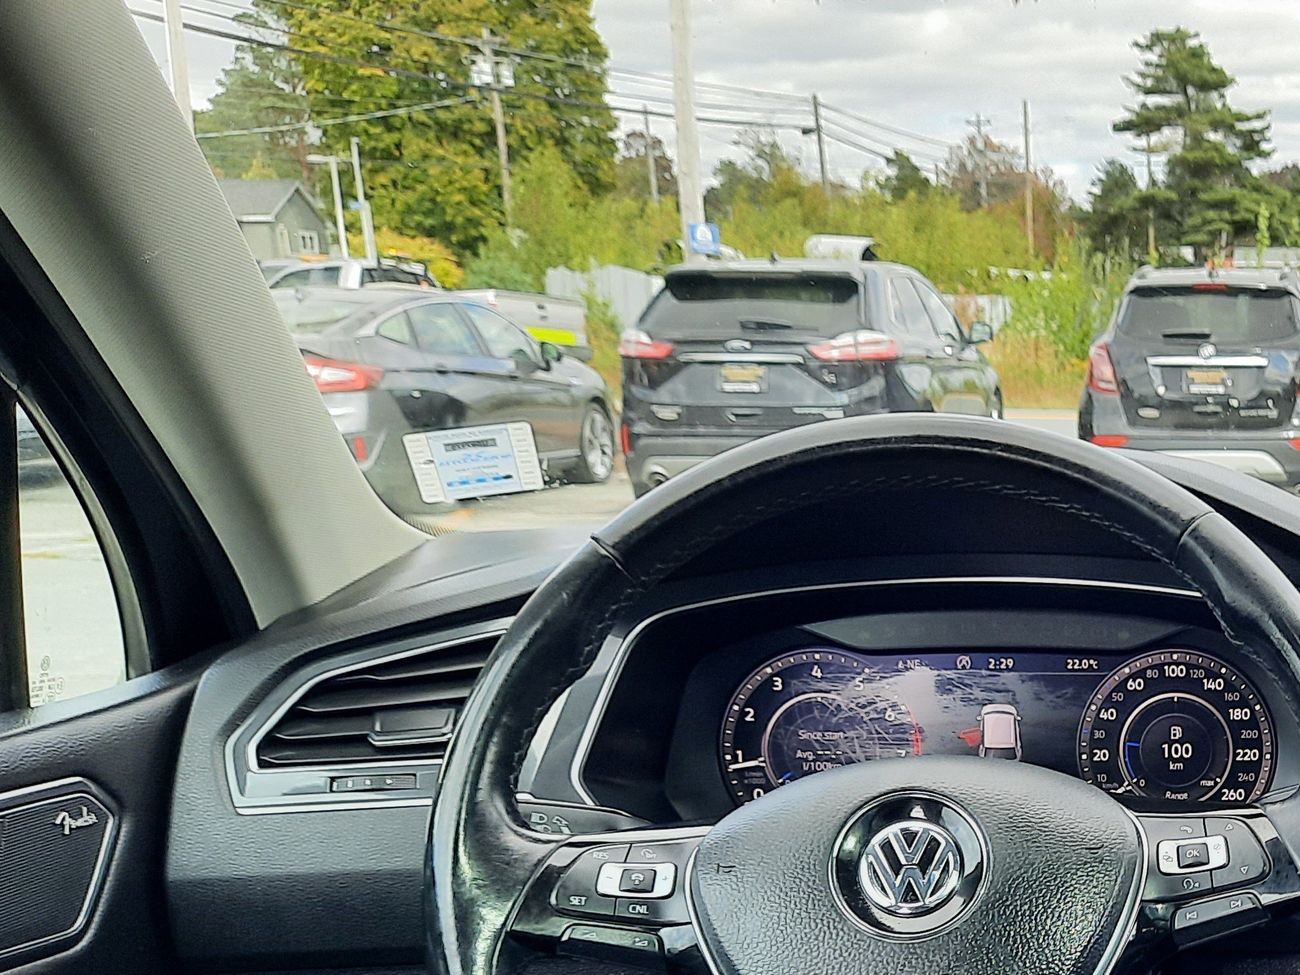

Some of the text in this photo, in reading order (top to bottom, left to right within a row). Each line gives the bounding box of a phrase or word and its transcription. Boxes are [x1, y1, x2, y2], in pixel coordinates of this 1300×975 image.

[988, 658, 1014, 669] 2:29
[811, 665, 823, 679] 4
[1146, 669, 1159, 679] 80
[1163, 665, 1187, 678] 100
[1189, 668, 1205, 679] 120
[772, 677, 783, 692] 3
[854, 678, 865, 691] 5
[1126, 678, 1144, 691] 60
[1203, 678, 1224, 691] 140
[1111, 692, 1124, 702] 50
[1224, 692, 1240, 702] 160
[744, 708, 756, 723] 2
[884, 708, 896, 722] 6
[1099, 708, 1117, 721] 40
[1228, 708, 1251, 721] 180
[798, 729, 822, 741] Since
[1093, 729, 1106, 740] 30
[1240, 729, 1259, 740] 200
[736, 750, 744, 763] 1
[796, 749, 817, 761] Avg.
[1092, 749, 1110, 762] 20
[1161, 742, 1193, 759] 100
[1235, 749, 1259, 762] 220
[1169, 760, 1184, 771] km
[1096, 773, 1107, 783] 10
[1139, 778, 1146, 788] 0
[1200, 779, 1215, 787] max
[1238, 772, 1255, 782] 240
[753, 786, 764, 800] 0
[1221, 788, 1245, 801] 260
[593, 851, 610, 861] RES
[1186, 848, 1200, 858] OK
[569, 896, 588, 906] SET
[629, 904, 650, 914] CNL
